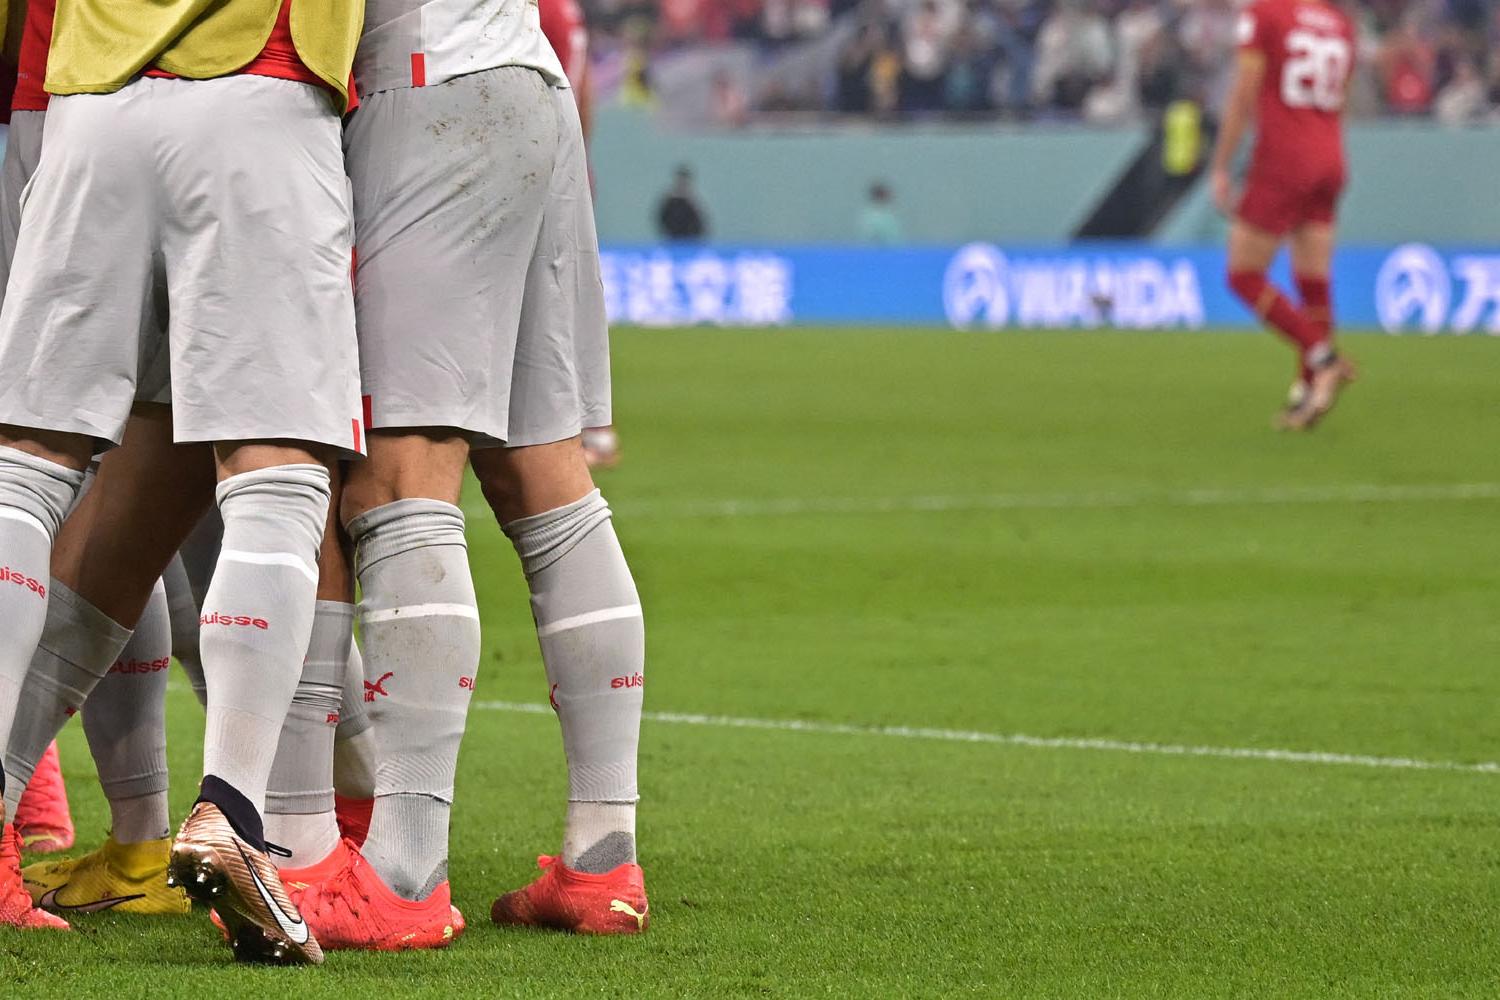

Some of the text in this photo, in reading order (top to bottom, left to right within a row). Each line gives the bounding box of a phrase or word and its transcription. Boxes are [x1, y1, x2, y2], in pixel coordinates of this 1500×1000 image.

[1281, 30, 1350, 112] 20
[1012, 257, 1206, 330] WANDA
[199, 611, 269, 630] suisse
